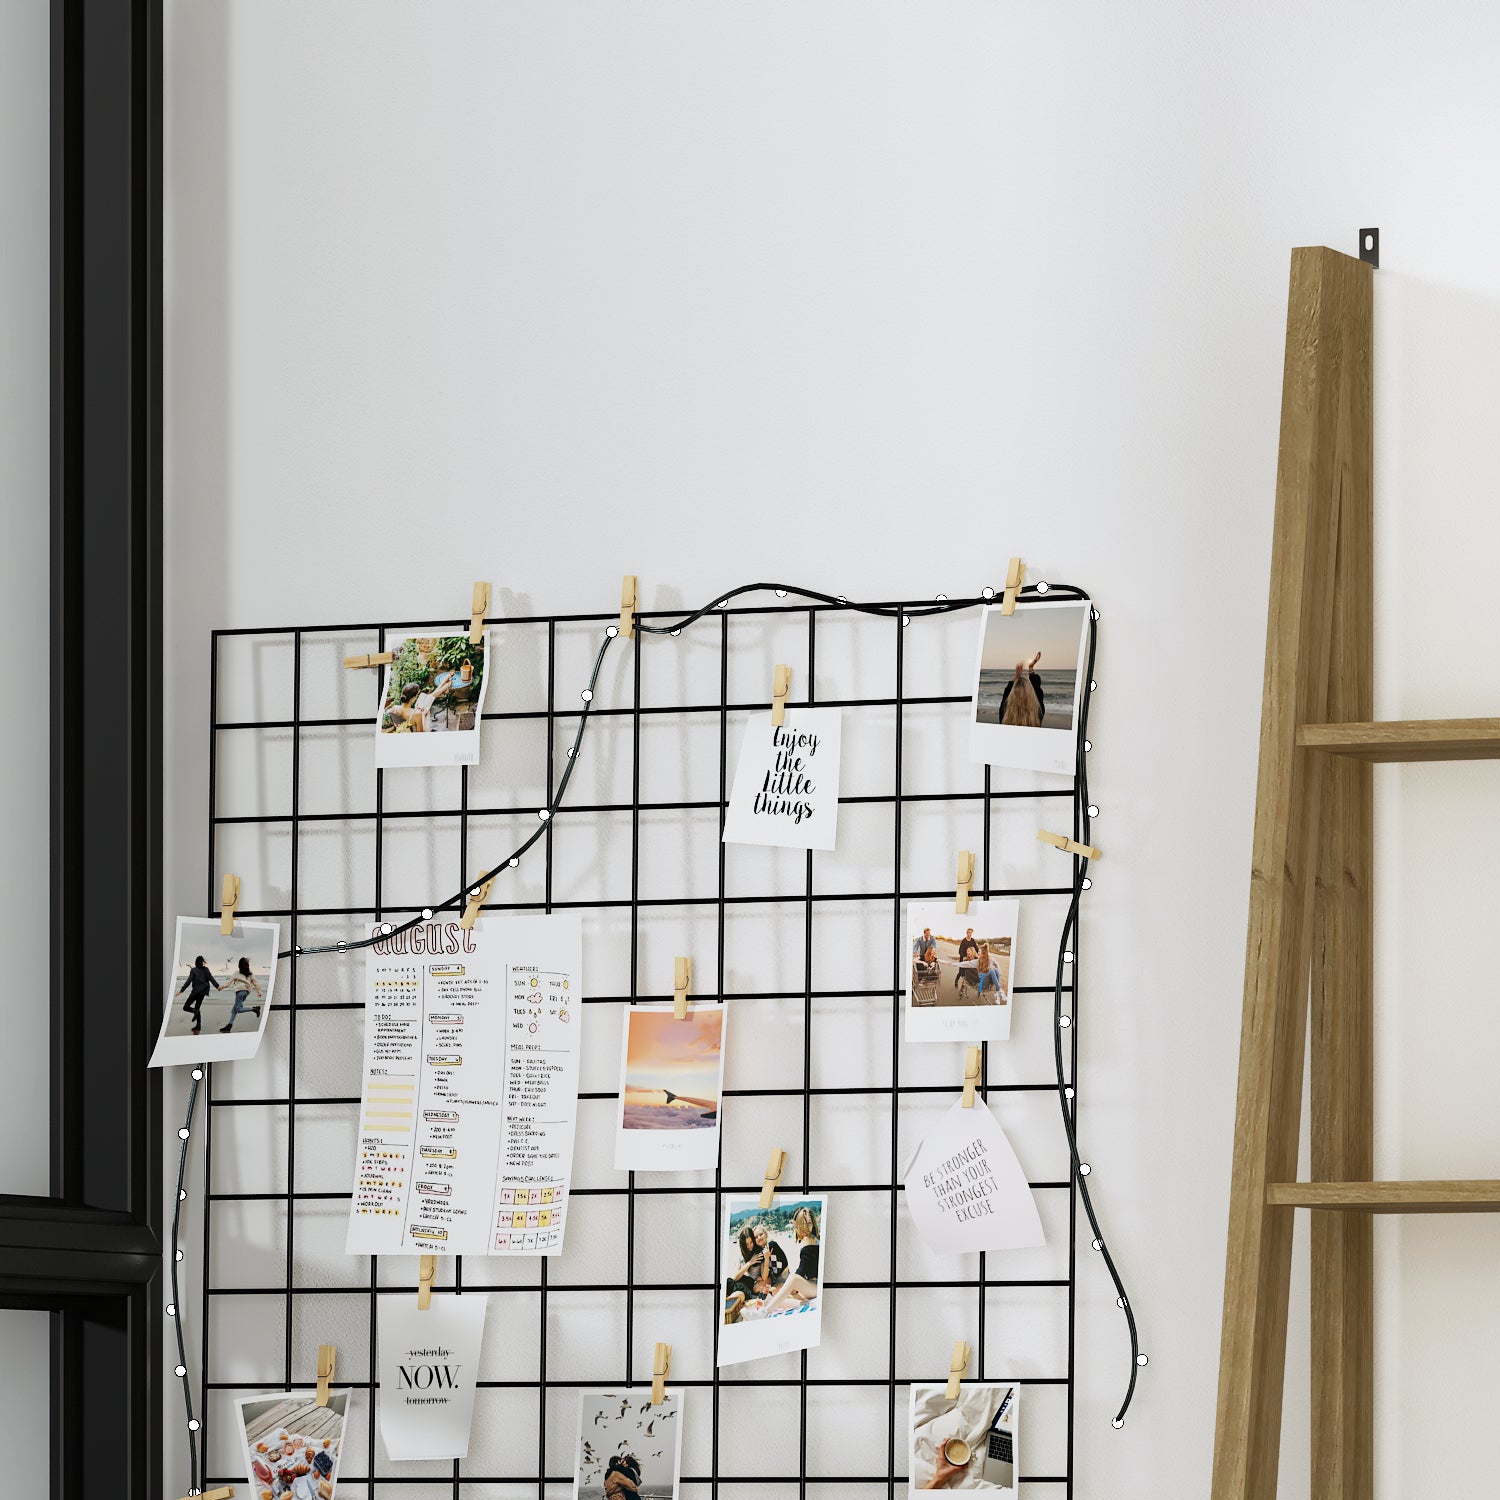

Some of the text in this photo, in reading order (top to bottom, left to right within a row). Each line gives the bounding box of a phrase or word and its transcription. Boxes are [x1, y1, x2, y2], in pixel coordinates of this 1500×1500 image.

[776, 751, 806, 772] the
[754, 792, 815, 824] things
[923, 1138, 988, 1188] BE STRONGER
[932, 1159, 992, 1198] THAN YOUR
[938, 1176, 998, 1212] STRONGEST
[956, 1199, 994, 1222] EXCUSE
[404, 1346, 455, 1360] yesterday
[395, 1364, 462, 1390] NOW.
[404, 1396, 450, 1405] tomorrow
